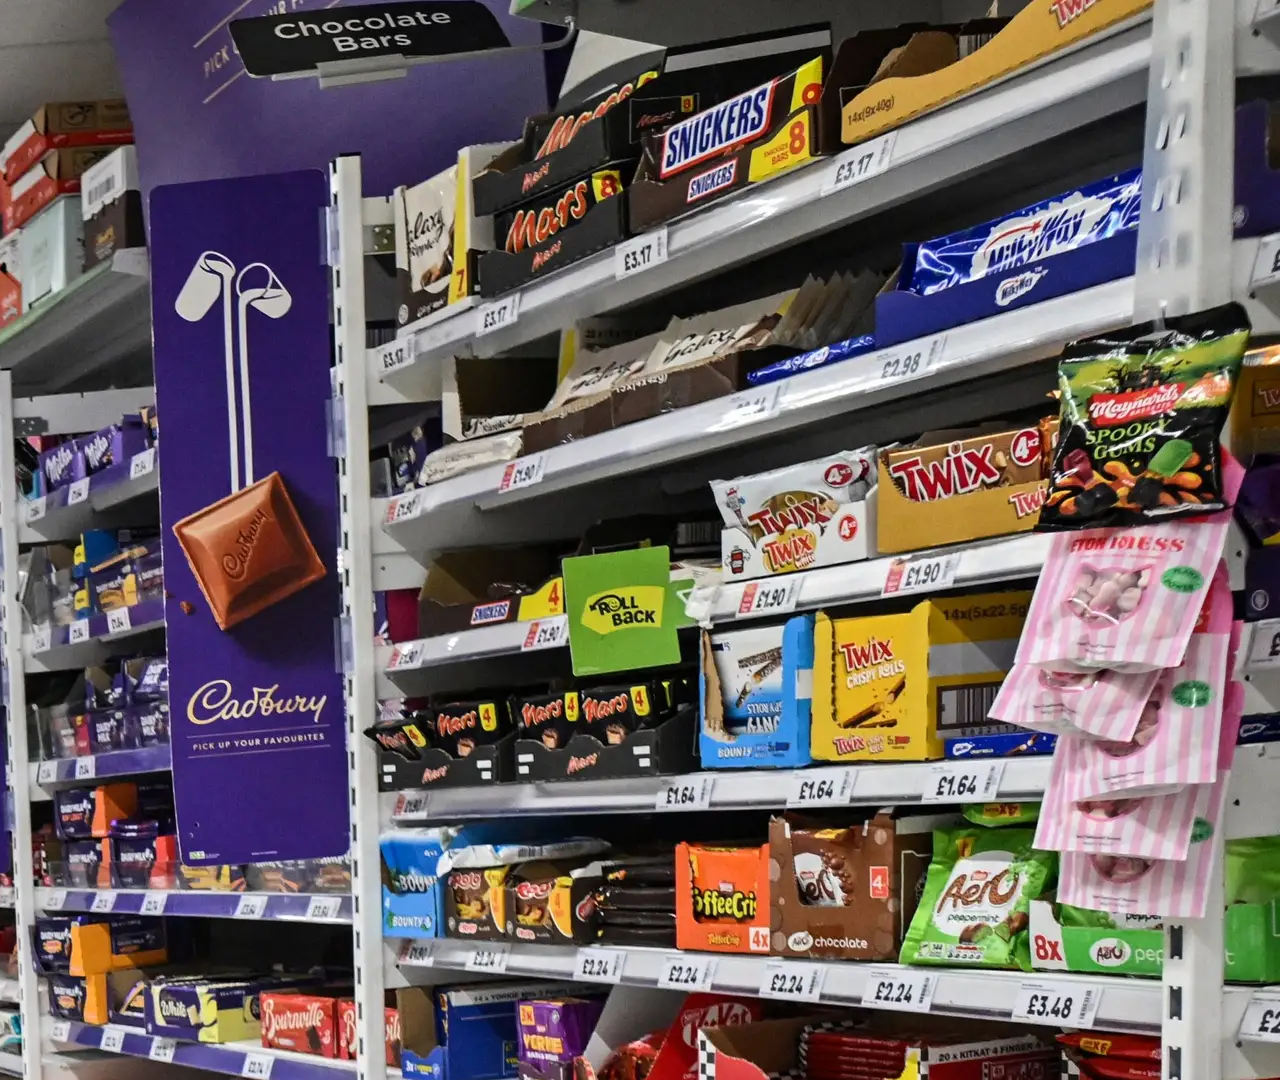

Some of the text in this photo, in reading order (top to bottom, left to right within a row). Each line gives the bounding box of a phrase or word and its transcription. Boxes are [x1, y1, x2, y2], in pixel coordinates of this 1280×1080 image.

[273, 7, 450, 40] Chocolate
[333, 29, 412, 53] Bars
[666, 90, 767, 166] SNICKERS
[789, 121, 805, 154] 8
[690, 163, 734, 199] SNICKERS
[834, 153, 873, 185] £3.17
[506, 175, 618, 253] Mars 8
[624, 244, 652, 271] £3.17
[484, 305, 507, 328] £3.17
[881, 352, 920, 380] £2.98
[1090, 383, 1182, 421] Maynards
[1086, 420, 1172, 447] SPOOKY
[1094, 438, 1157, 461] GUMS
[45, 447, 73, 484] Milka
[904, 567, 941, 588] £1.90
[598, 593, 639, 613] ROLL
[755, 586, 786, 609] £1.90
[186, 679, 328, 724] Cadbury
[193, 733, 326, 751] PICK UP YOUR FAVOURITES
[666, 786, 696, 805] £1.64
[800, 780, 834, 800] £1.64
[936, 776, 977, 797] £1.64
[393, 916, 424, 928] BOUNTY
[947, 912, 1001, 925] peppermint
[1034, 935, 1063, 961] 8x
[582, 961, 609, 977] £2.24
[668, 965, 698, 985] £2.24
[770, 975, 804, 995] £2.24
[875, 982, 913, 1003] £2.24
[263, 998, 324, 1039] Bournville
[1026, 995, 1073, 1019] £3.48
